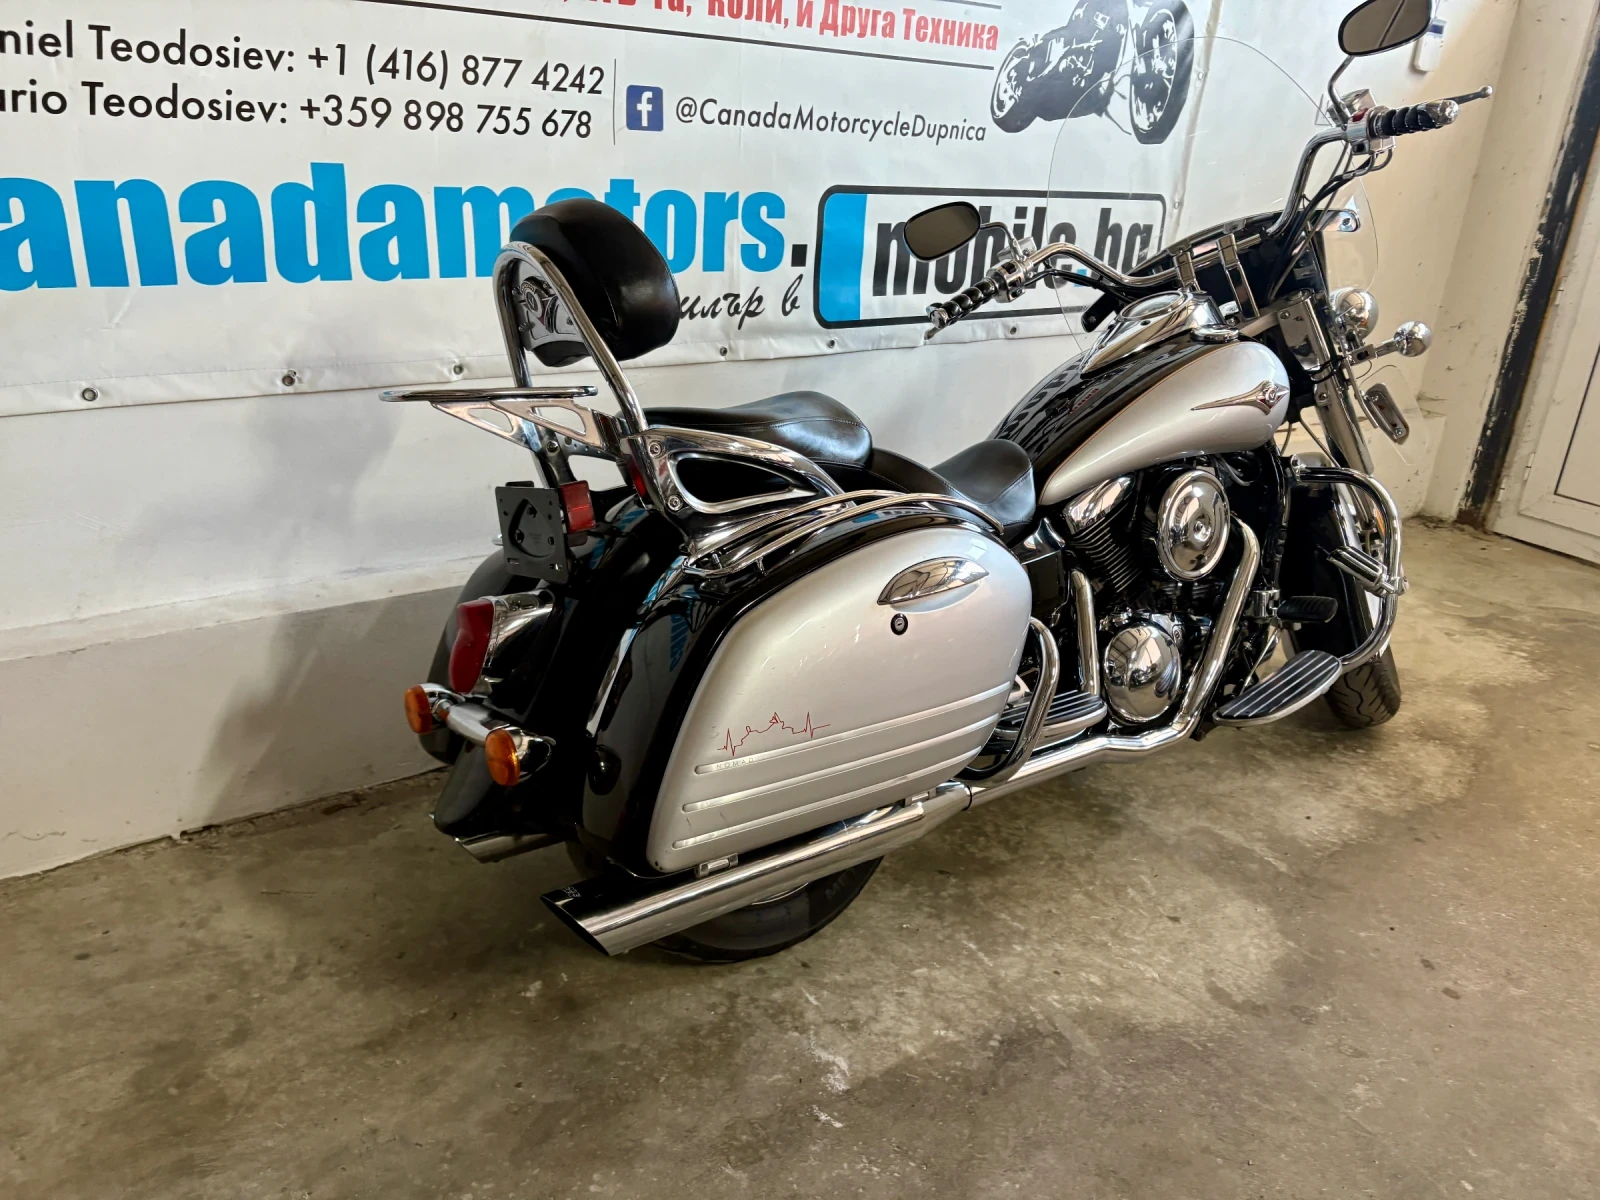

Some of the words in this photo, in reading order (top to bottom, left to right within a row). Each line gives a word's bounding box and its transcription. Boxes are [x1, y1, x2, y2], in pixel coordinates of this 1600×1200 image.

[819, 0, 896, 39] Друга
[902, 7, 999, 50] Техника
[0, 19, 74, 58] niel
[87, 24, 295, 73] Teodosiev:
[308, 43, 346, 76] +1
[366, 43, 448, 90] (416)
[462, 54, 523, 89] 877
[531, 61, 605, 95] 4242
[80, 80, 288, 124] Teodosiev:
[300, 94, 392, 129] +359
[403, 99, 464, 133] 898
[476, 104, 532, 136] 755
[541, 108, 592, 139] 678
[675, 96, 986, 145] @CanadaMotorcycleDupnica
